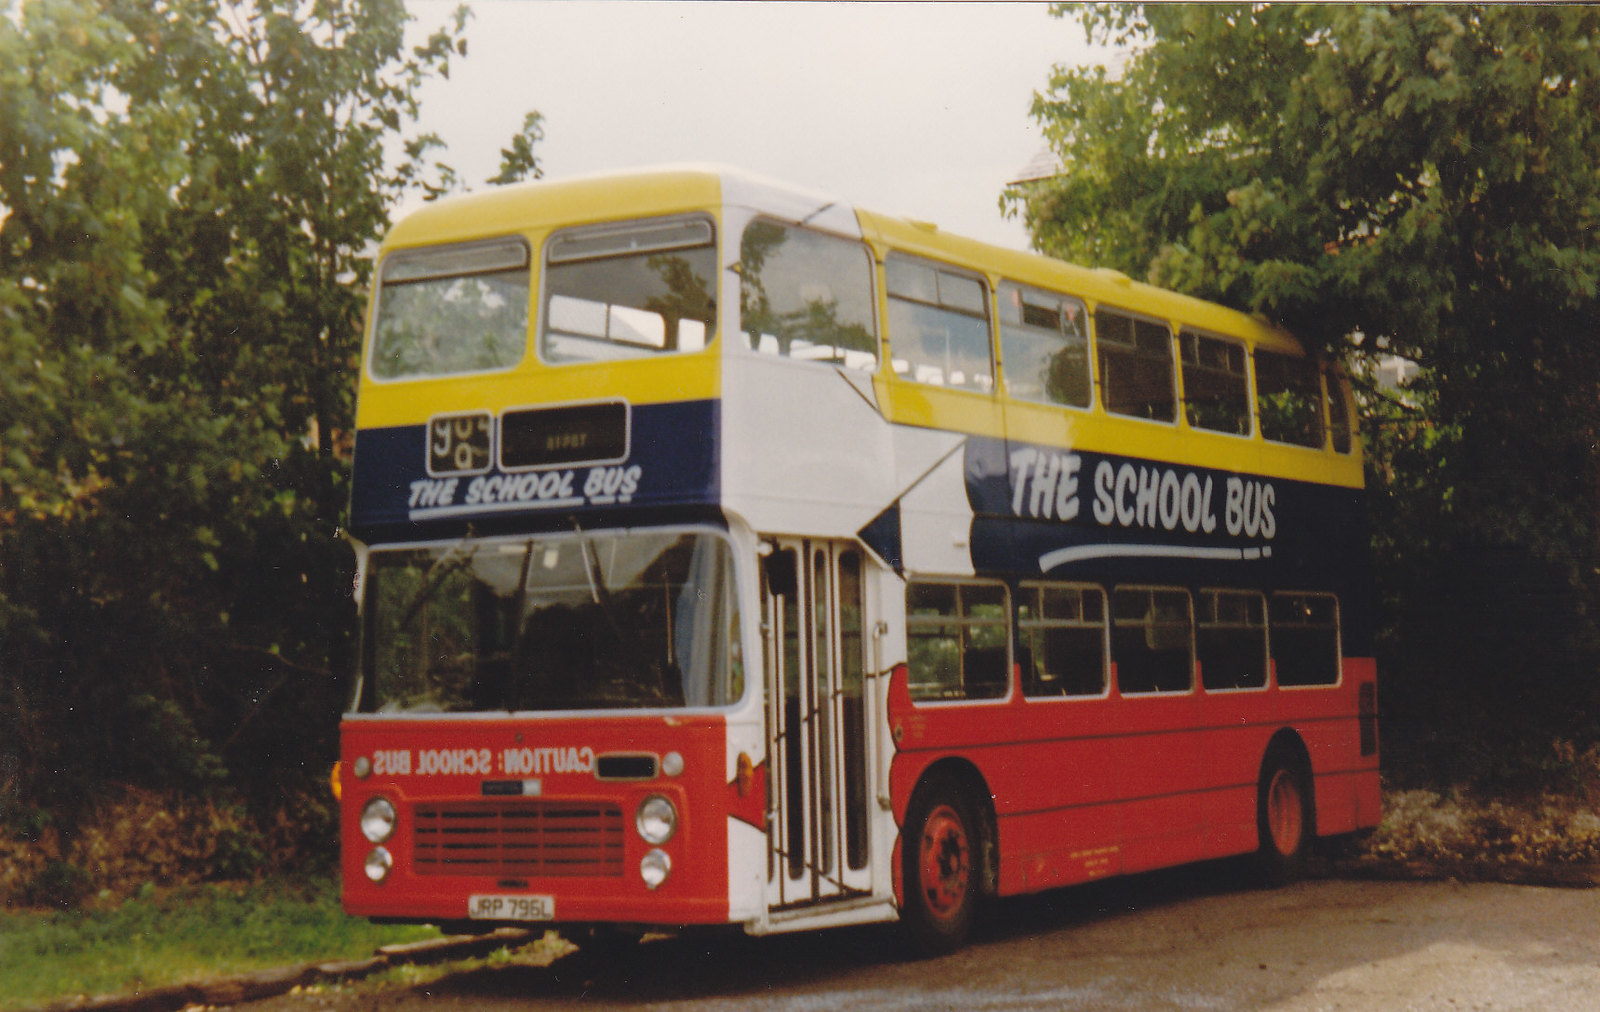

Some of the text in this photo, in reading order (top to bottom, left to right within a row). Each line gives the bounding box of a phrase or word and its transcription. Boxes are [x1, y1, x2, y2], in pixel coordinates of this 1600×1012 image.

[408, 465, 642, 508] THE SCHOOL BUS
[1009, 447, 1276, 539] THE SCHOOL BUS
[470, 898, 552, 918] JRP 796L
